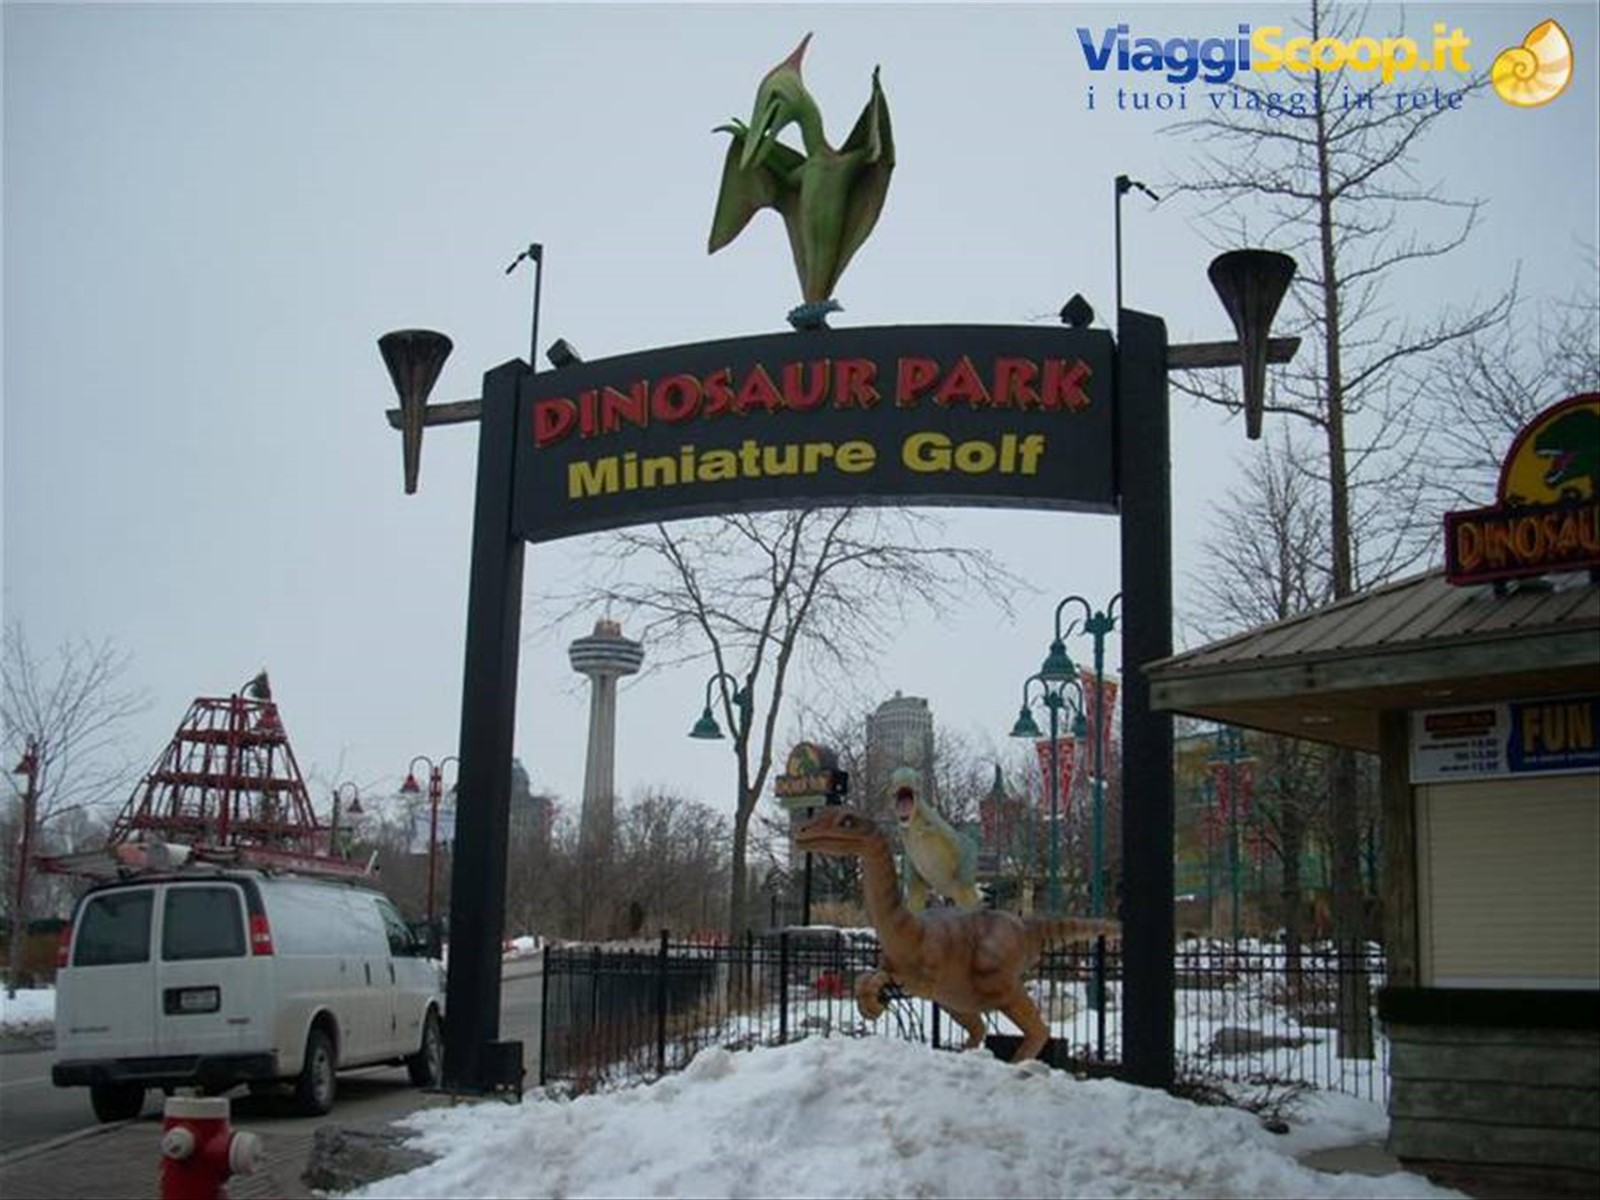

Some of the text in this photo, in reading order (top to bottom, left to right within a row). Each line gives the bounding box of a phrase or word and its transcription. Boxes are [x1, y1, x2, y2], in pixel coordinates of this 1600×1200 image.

[534, 355, 1092, 447] DINOSAUR PARK
[567, 431, 1046, 499] Miniature Golf
[1522, 701, 1594, 753] FUN
